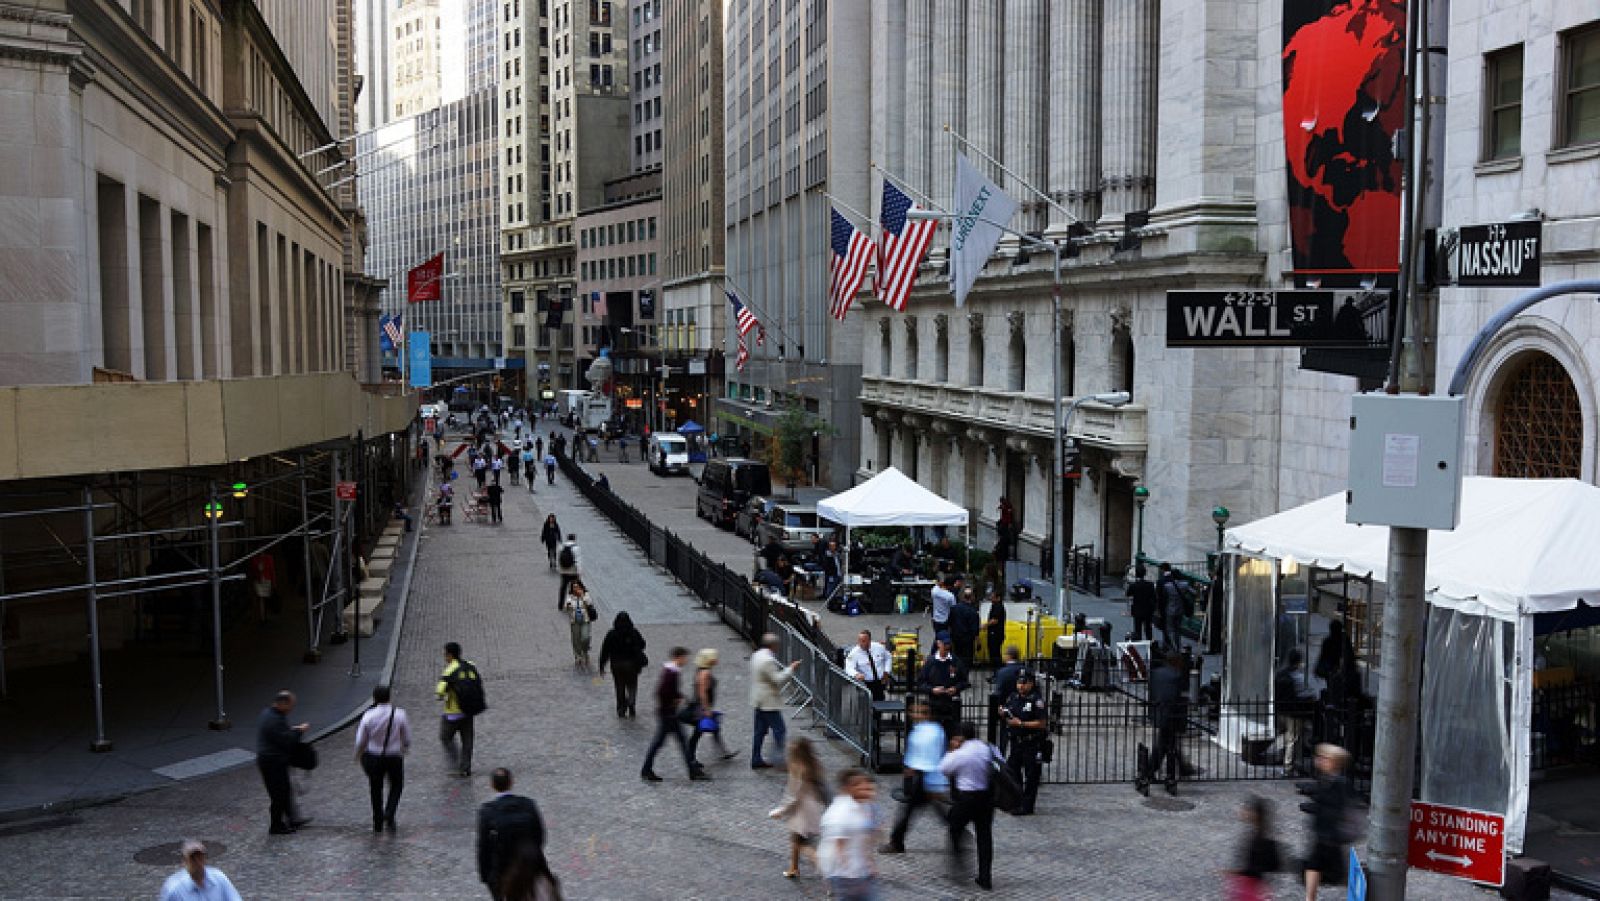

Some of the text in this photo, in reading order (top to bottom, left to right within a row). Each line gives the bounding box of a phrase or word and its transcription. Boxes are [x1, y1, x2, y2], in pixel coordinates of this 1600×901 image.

[1461, 237, 1538, 276] NASSAU ST
[1183, 304, 1319, 337] WALL ST
[1429, 811, 1499, 837] STANDING
[1415, 828, 1487, 854] ANYTIME
